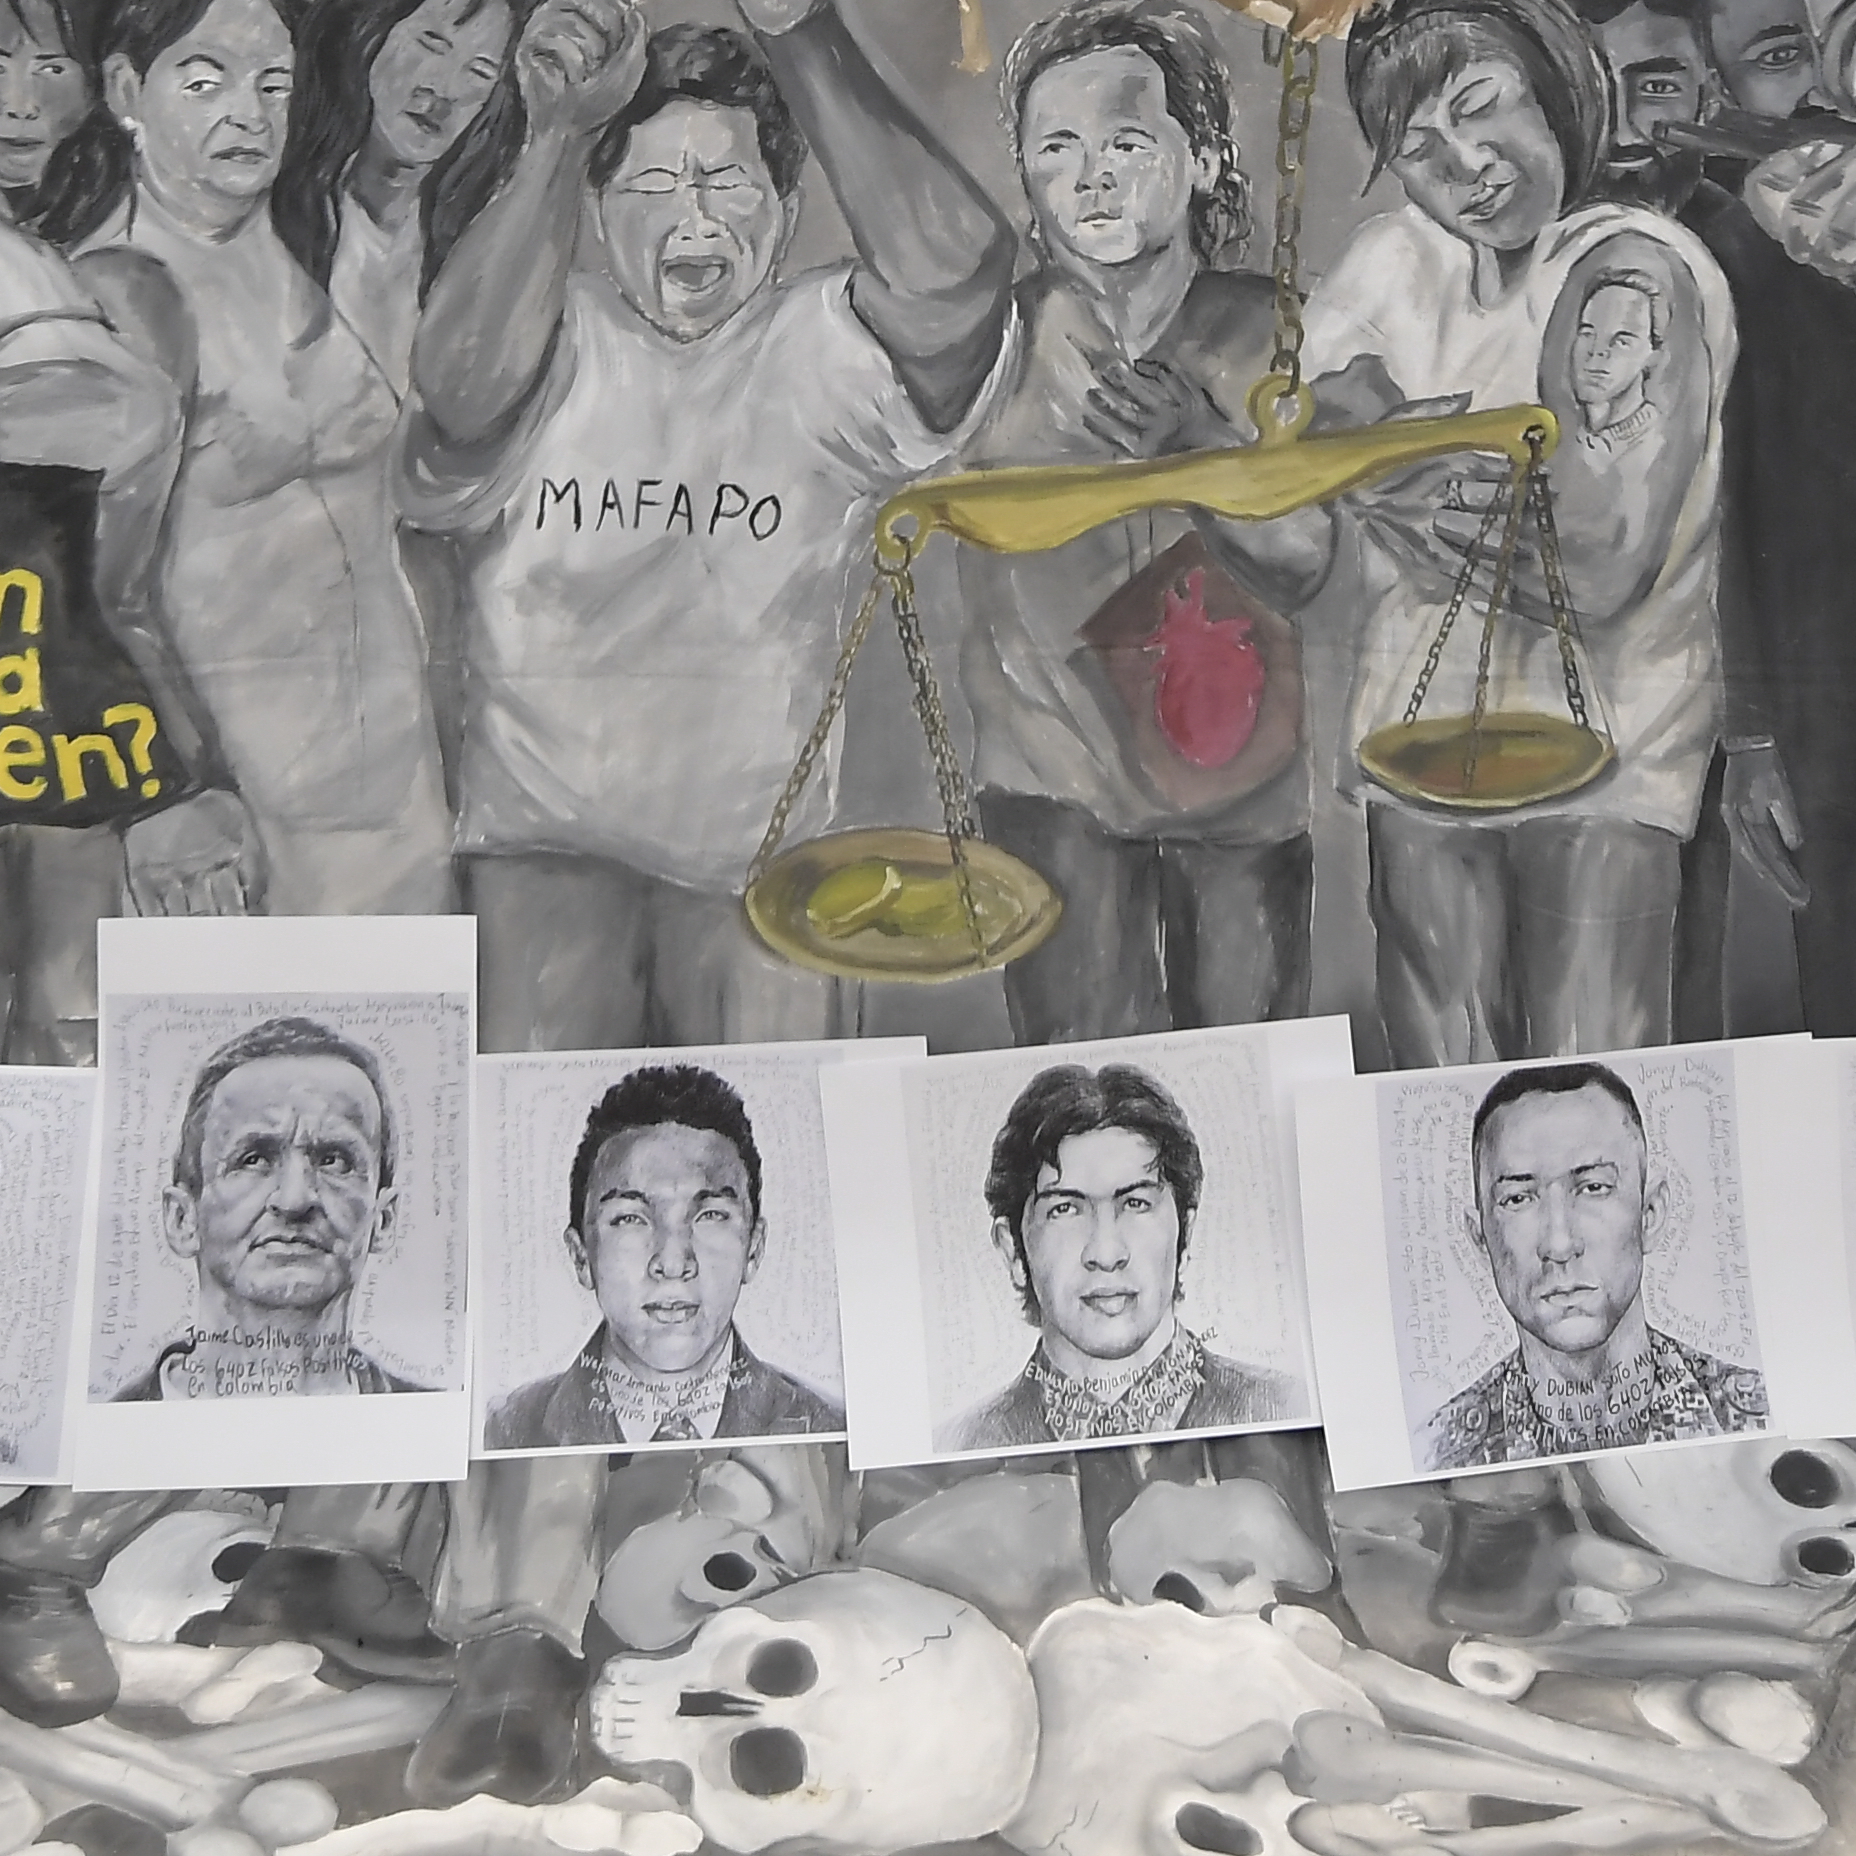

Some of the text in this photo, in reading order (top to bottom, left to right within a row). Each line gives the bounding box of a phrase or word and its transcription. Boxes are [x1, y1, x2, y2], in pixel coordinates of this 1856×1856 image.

[536, 476, 783, 541] MAFAPO
[185, 1324, 229, 1346] Jaime
[215, 1355, 259, 1379] 6402
[1557, 1401, 1575, 1423] de
[1579, 1401, 1604, 1423] los
[1607, 1376, 1654, 1416] 6402
